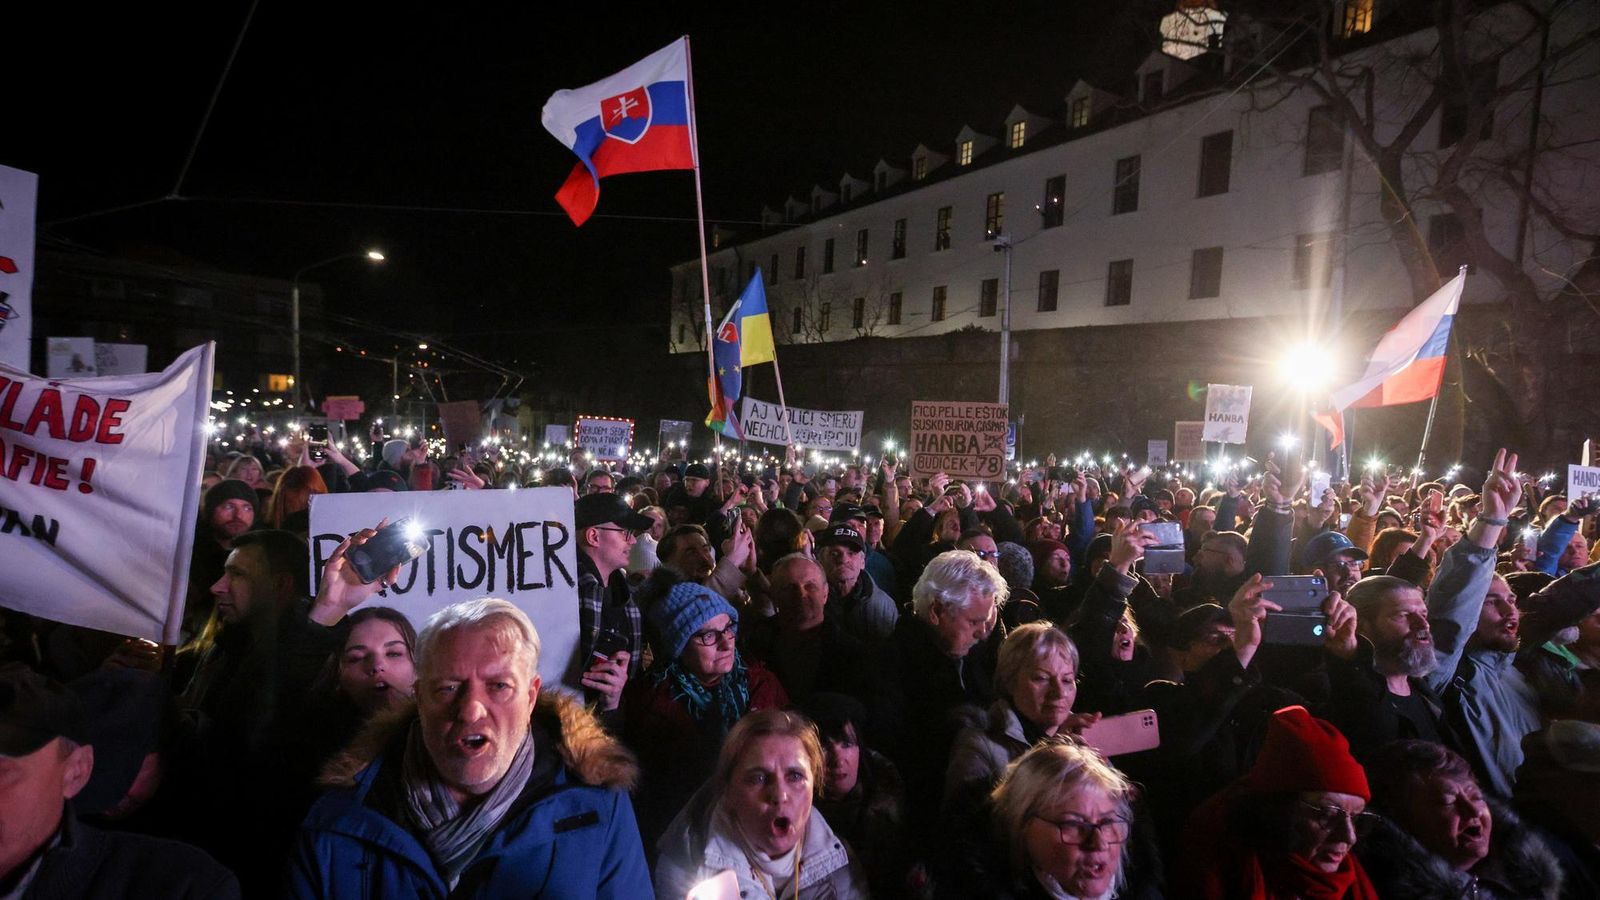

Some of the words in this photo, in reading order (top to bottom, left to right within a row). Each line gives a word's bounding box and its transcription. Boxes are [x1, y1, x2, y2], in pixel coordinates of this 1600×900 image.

[750, 403, 767, 420] AJ
[819, 411, 857, 429] SMERU
[1208, 413, 1244, 424] HANBA
[915, 433, 981, 454] HANBA
[0, 506, 60, 547] AN
[312, 520, 575, 597] PTISMER
